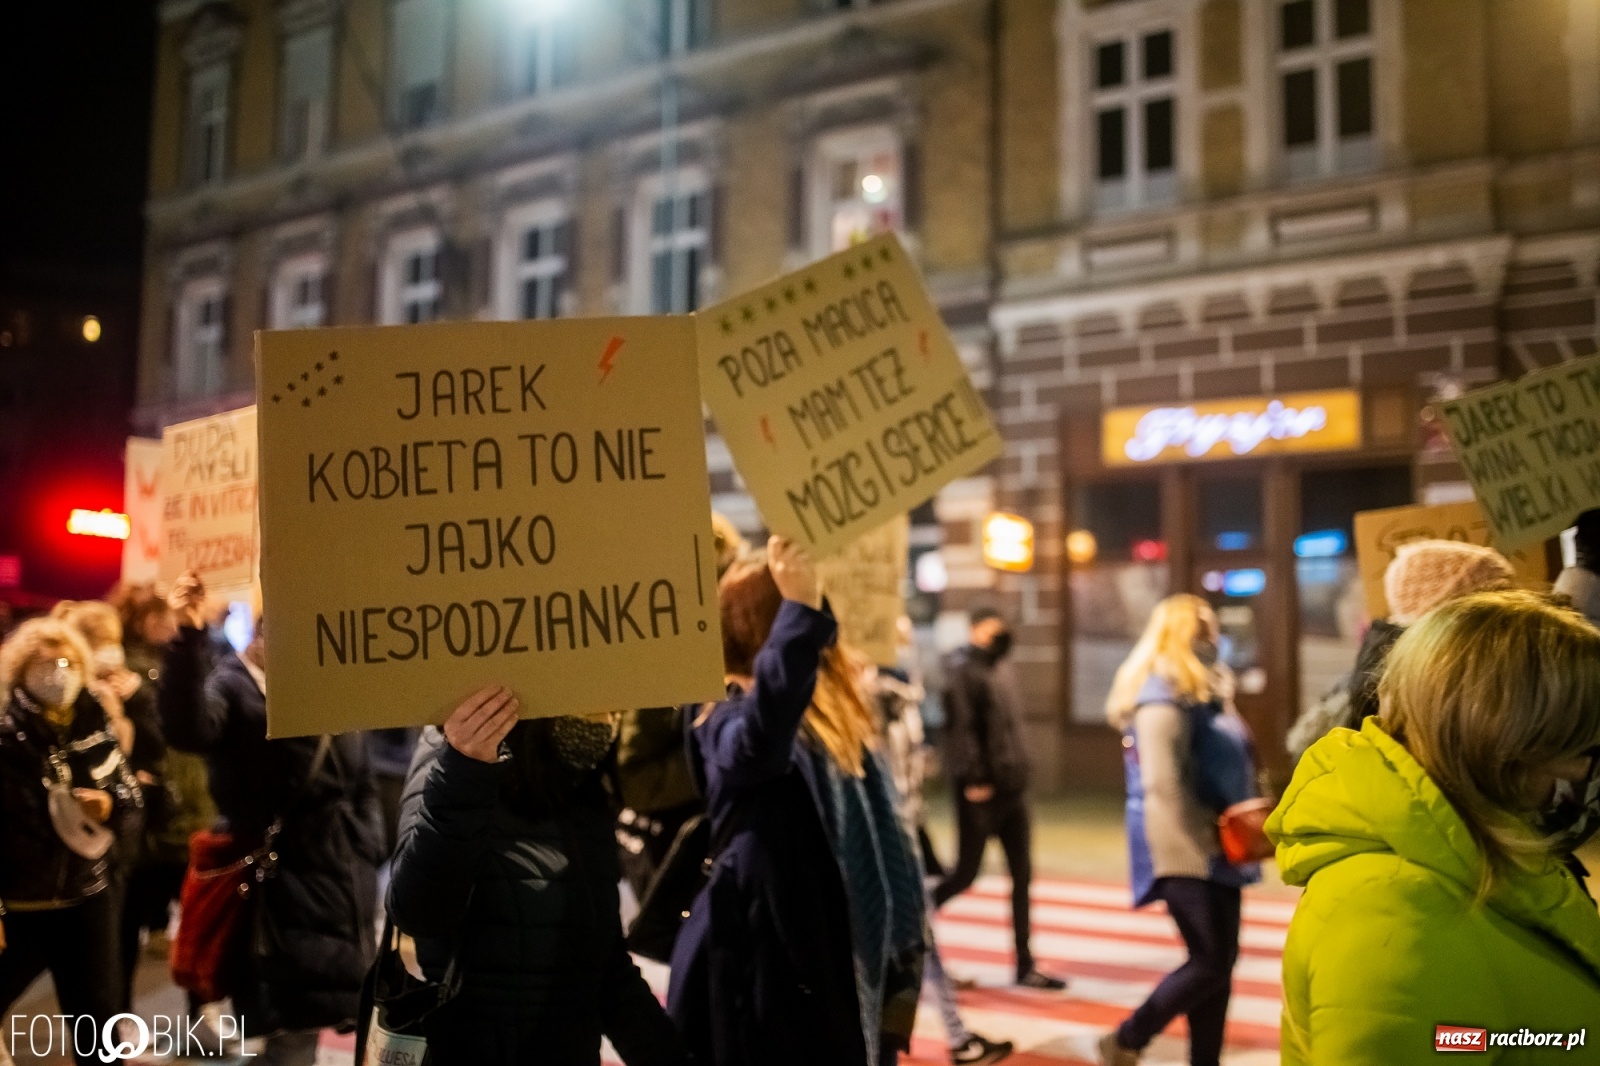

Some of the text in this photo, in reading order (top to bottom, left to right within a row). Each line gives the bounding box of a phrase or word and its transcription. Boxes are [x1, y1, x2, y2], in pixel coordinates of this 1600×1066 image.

[395, 363, 547, 420] JAREK
[717, 330, 804, 398] POZA
[786, 376, 864, 451] MAM
[1444, 390, 1529, 446] JAREK
[1525, 380, 1566, 418] TO
[307, 427, 666, 503] KOBIETA TO NIE
[785, 454, 880, 545] MÓZG
[405, 514, 556, 576] JAJKO
